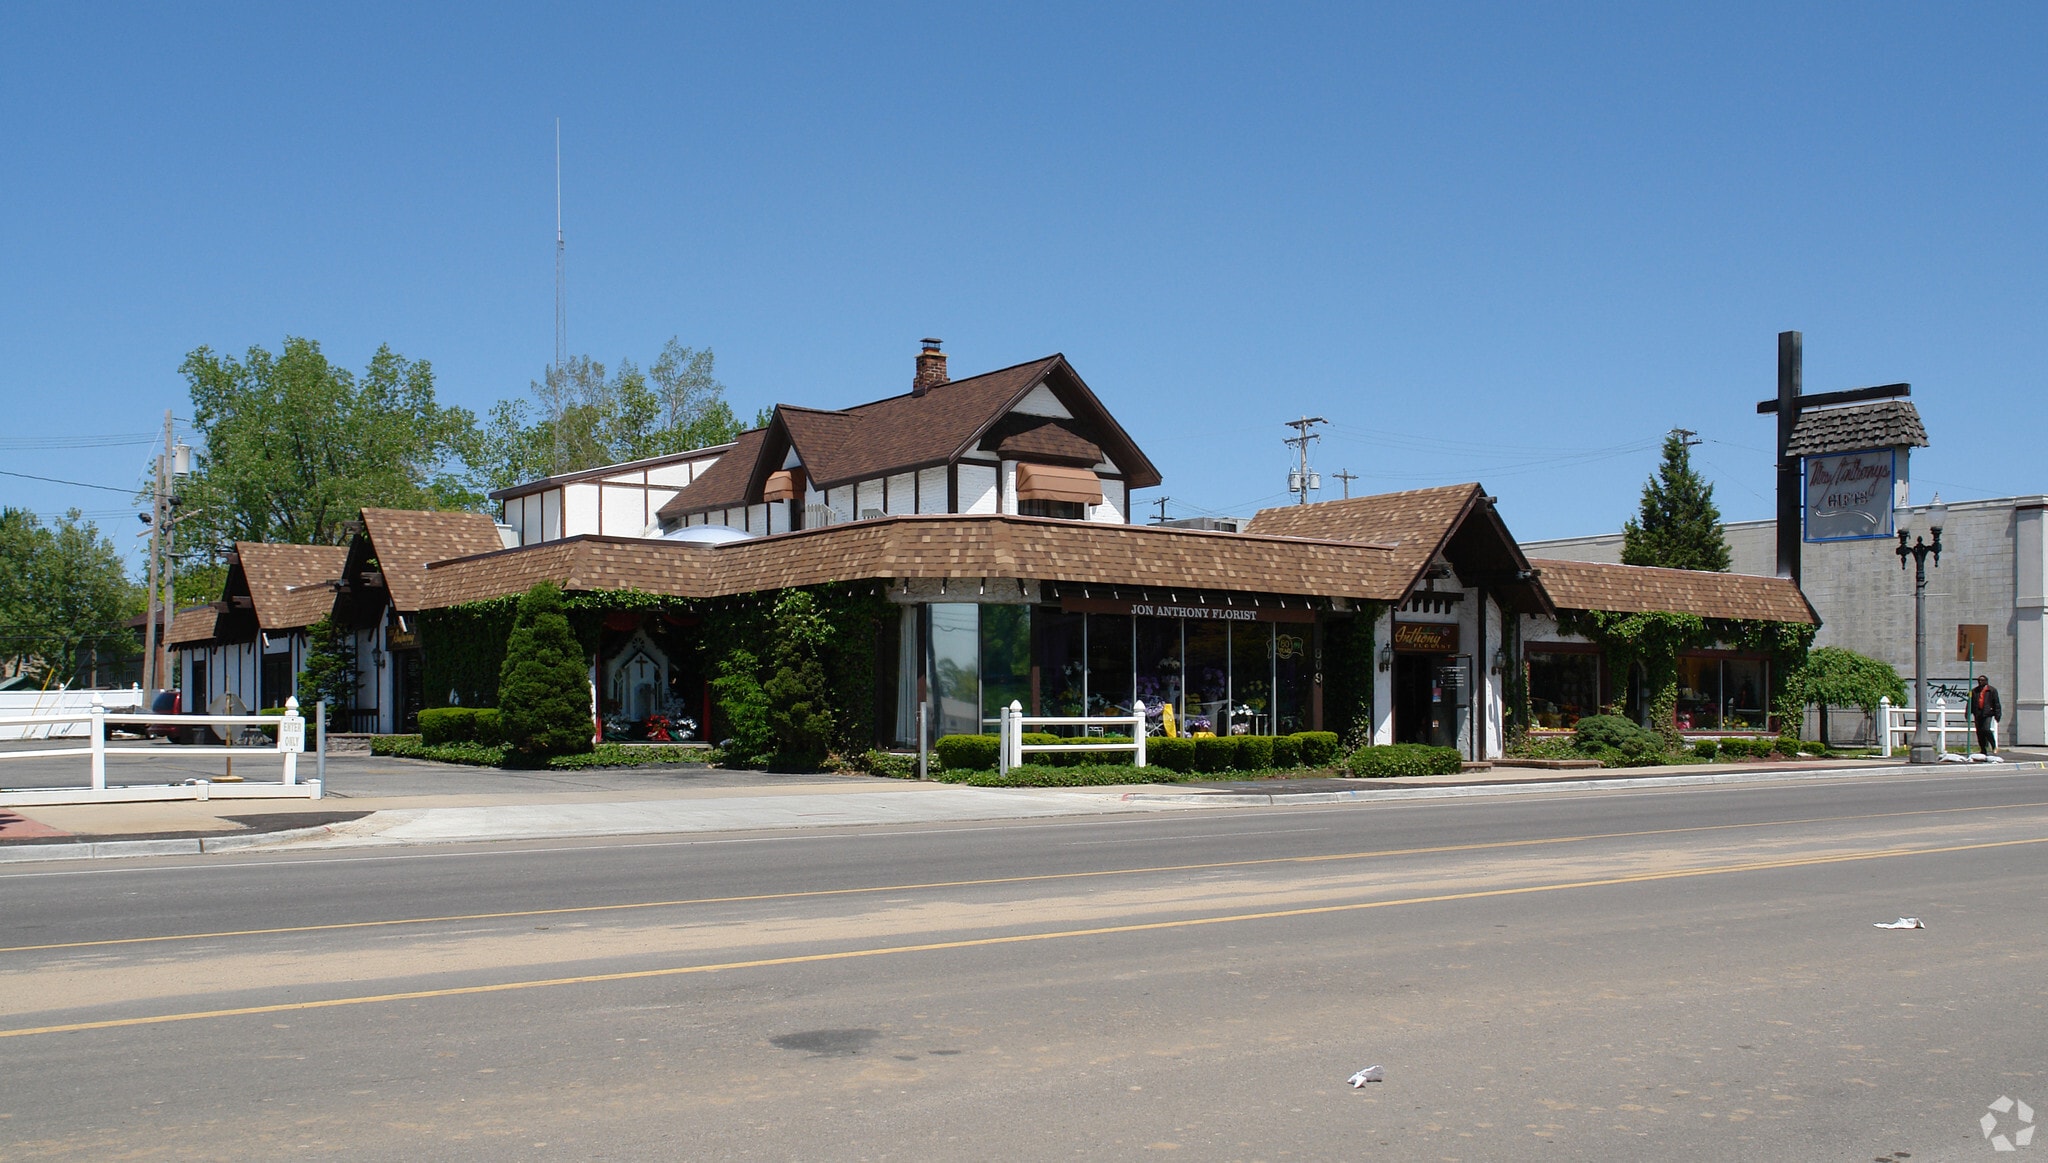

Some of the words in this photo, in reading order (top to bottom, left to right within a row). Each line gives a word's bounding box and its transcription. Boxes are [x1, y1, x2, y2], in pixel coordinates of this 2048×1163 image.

[1131, 604, 1154, 616] JON
[1156, 606, 1209, 619] ANTHONY
[1212, 609, 1257, 621] FLORIST
[1395, 625, 1441, 646] Anthony
[1931, 684, 1969, 699] Anthon
[283, 722, 302, 732] ENTER
[284, 736, 300, 747] ONLY
